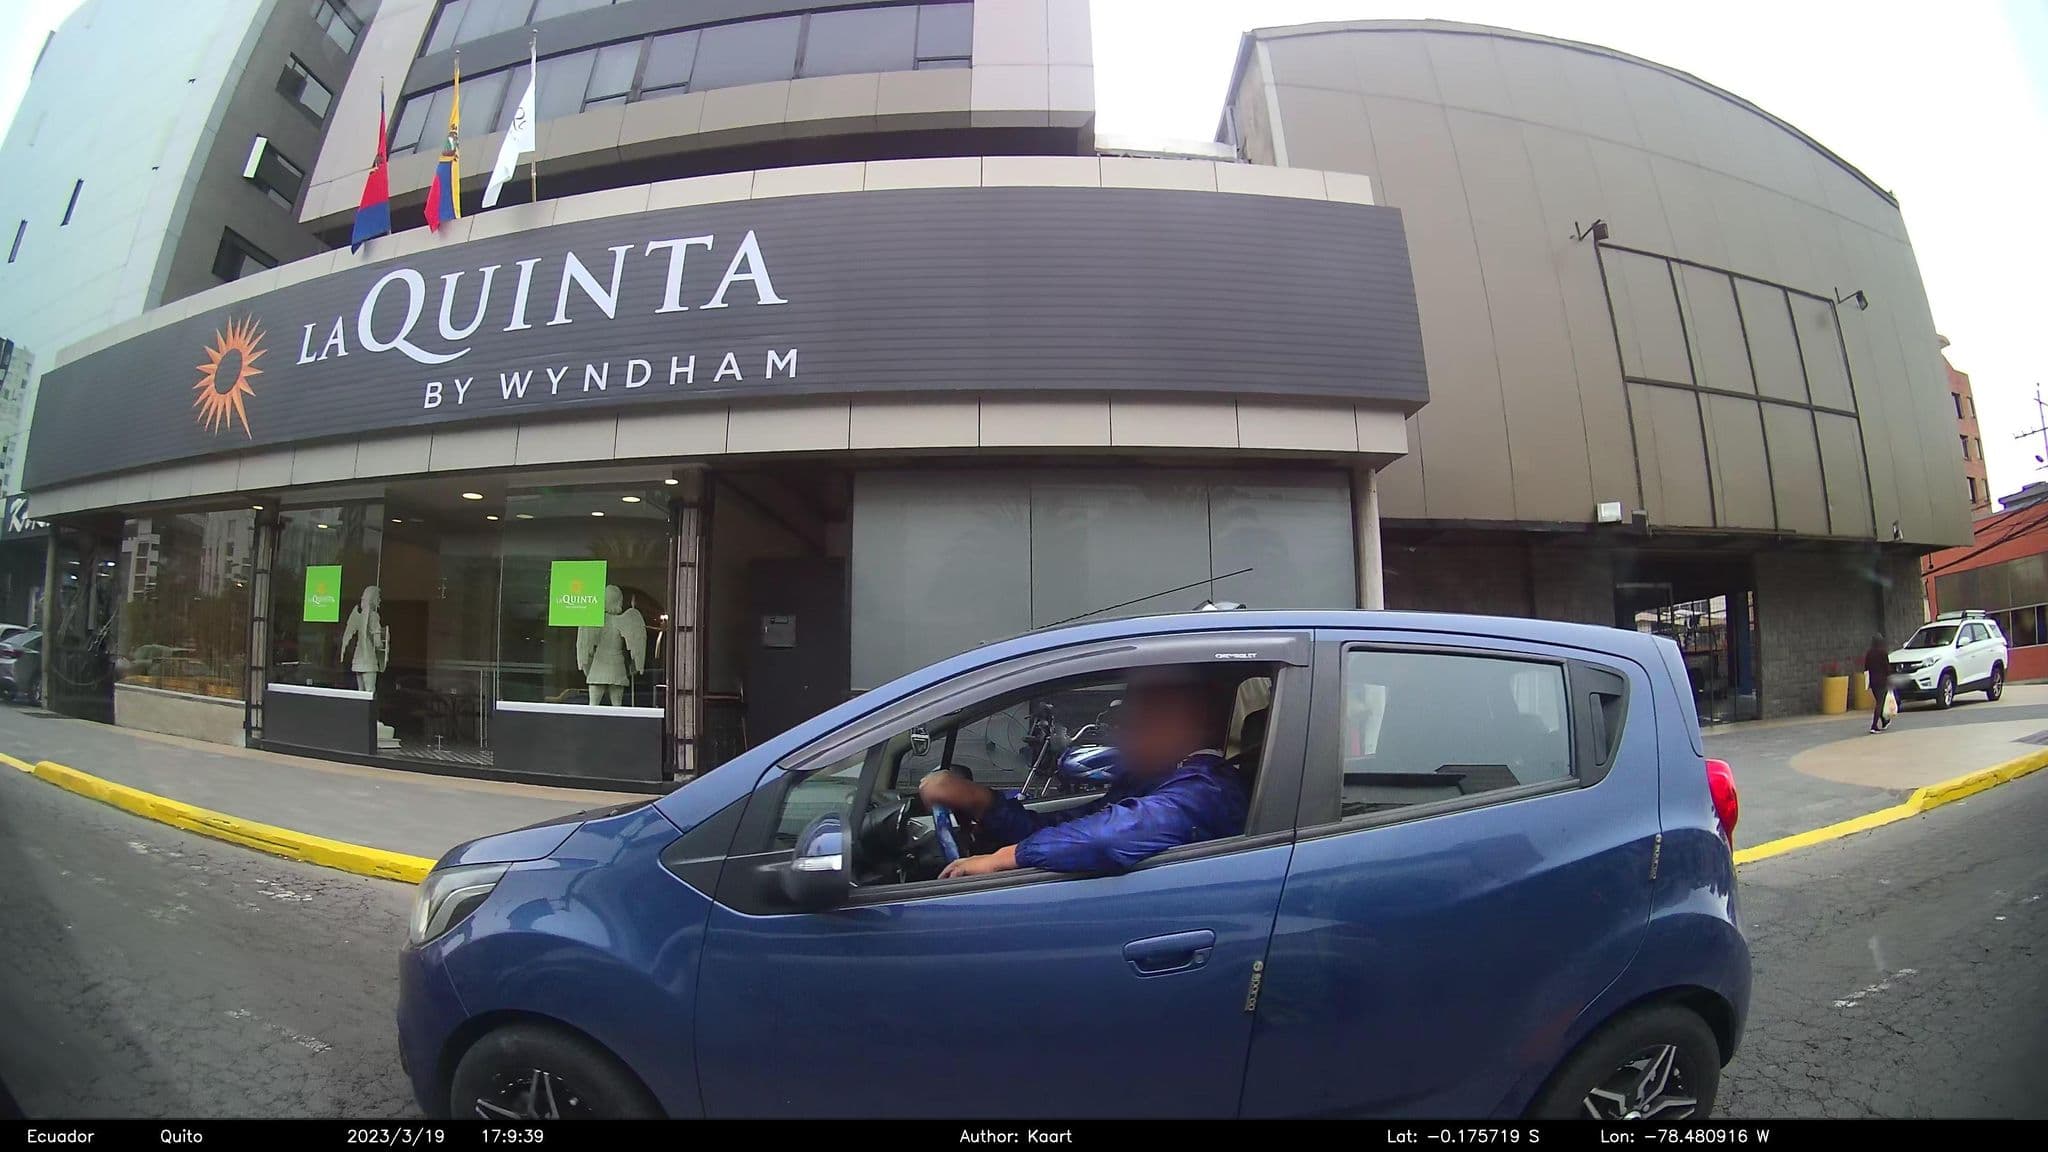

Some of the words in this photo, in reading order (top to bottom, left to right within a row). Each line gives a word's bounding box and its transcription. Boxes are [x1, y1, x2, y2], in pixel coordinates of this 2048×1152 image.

[297, 315, 349, 365] LA
[357, 229, 789, 365] QUINTA
[423, 376, 474, 409] BY
[499, 348, 798, 400] WYNDHAM
[562, 594, 598, 606] QUINTA
